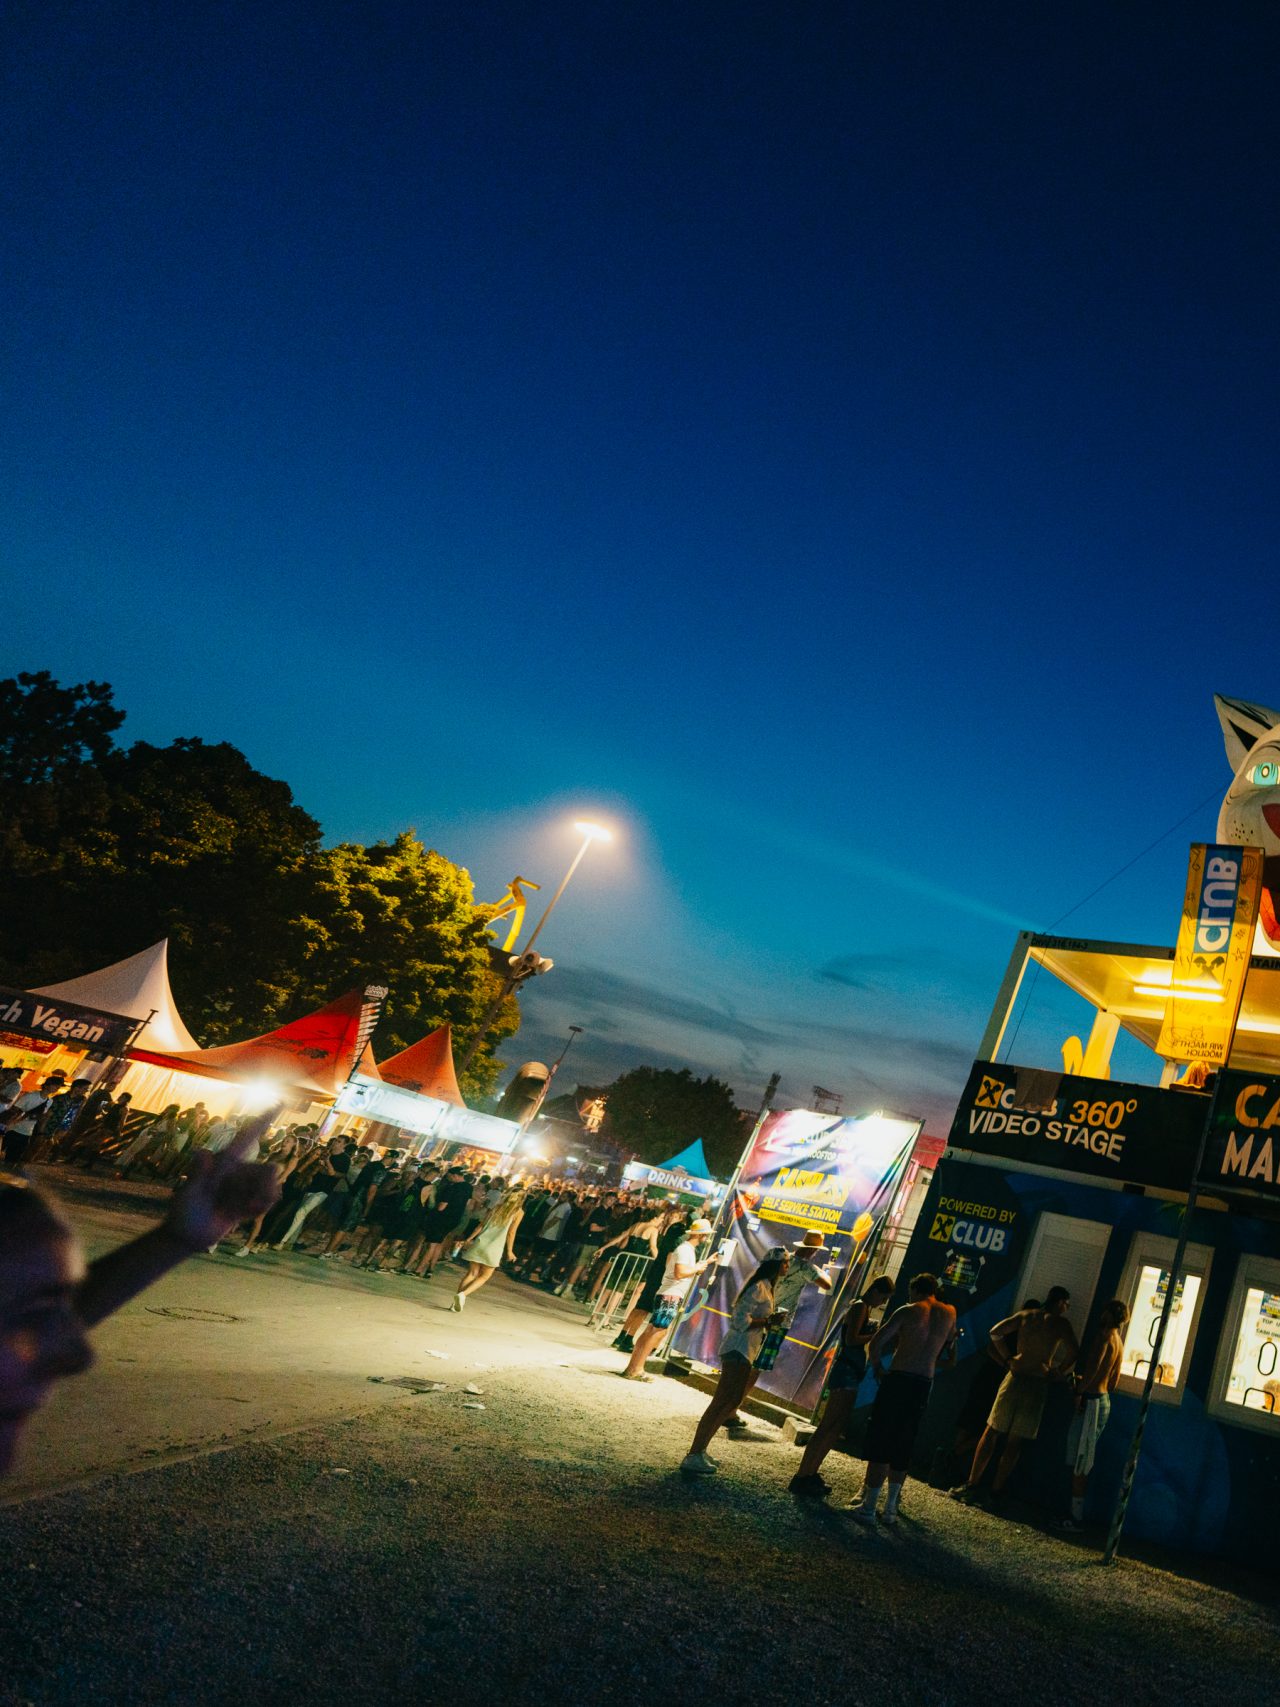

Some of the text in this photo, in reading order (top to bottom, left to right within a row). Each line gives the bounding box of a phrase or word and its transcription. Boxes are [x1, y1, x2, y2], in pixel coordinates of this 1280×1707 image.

[31, 1005, 105, 1043] Vegan
[1069, 1098, 1138, 1130] 360°
[969, 1109, 1126, 1163] VIDEO STAGE
[648, 1170, 694, 1191] DRINKS
[761, 1196, 843, 1223] SELF SERVICE STATION
[938, 1197, 1017, 1224] POWERED BY
[952, 1220, 1006, 1251] CLUB
